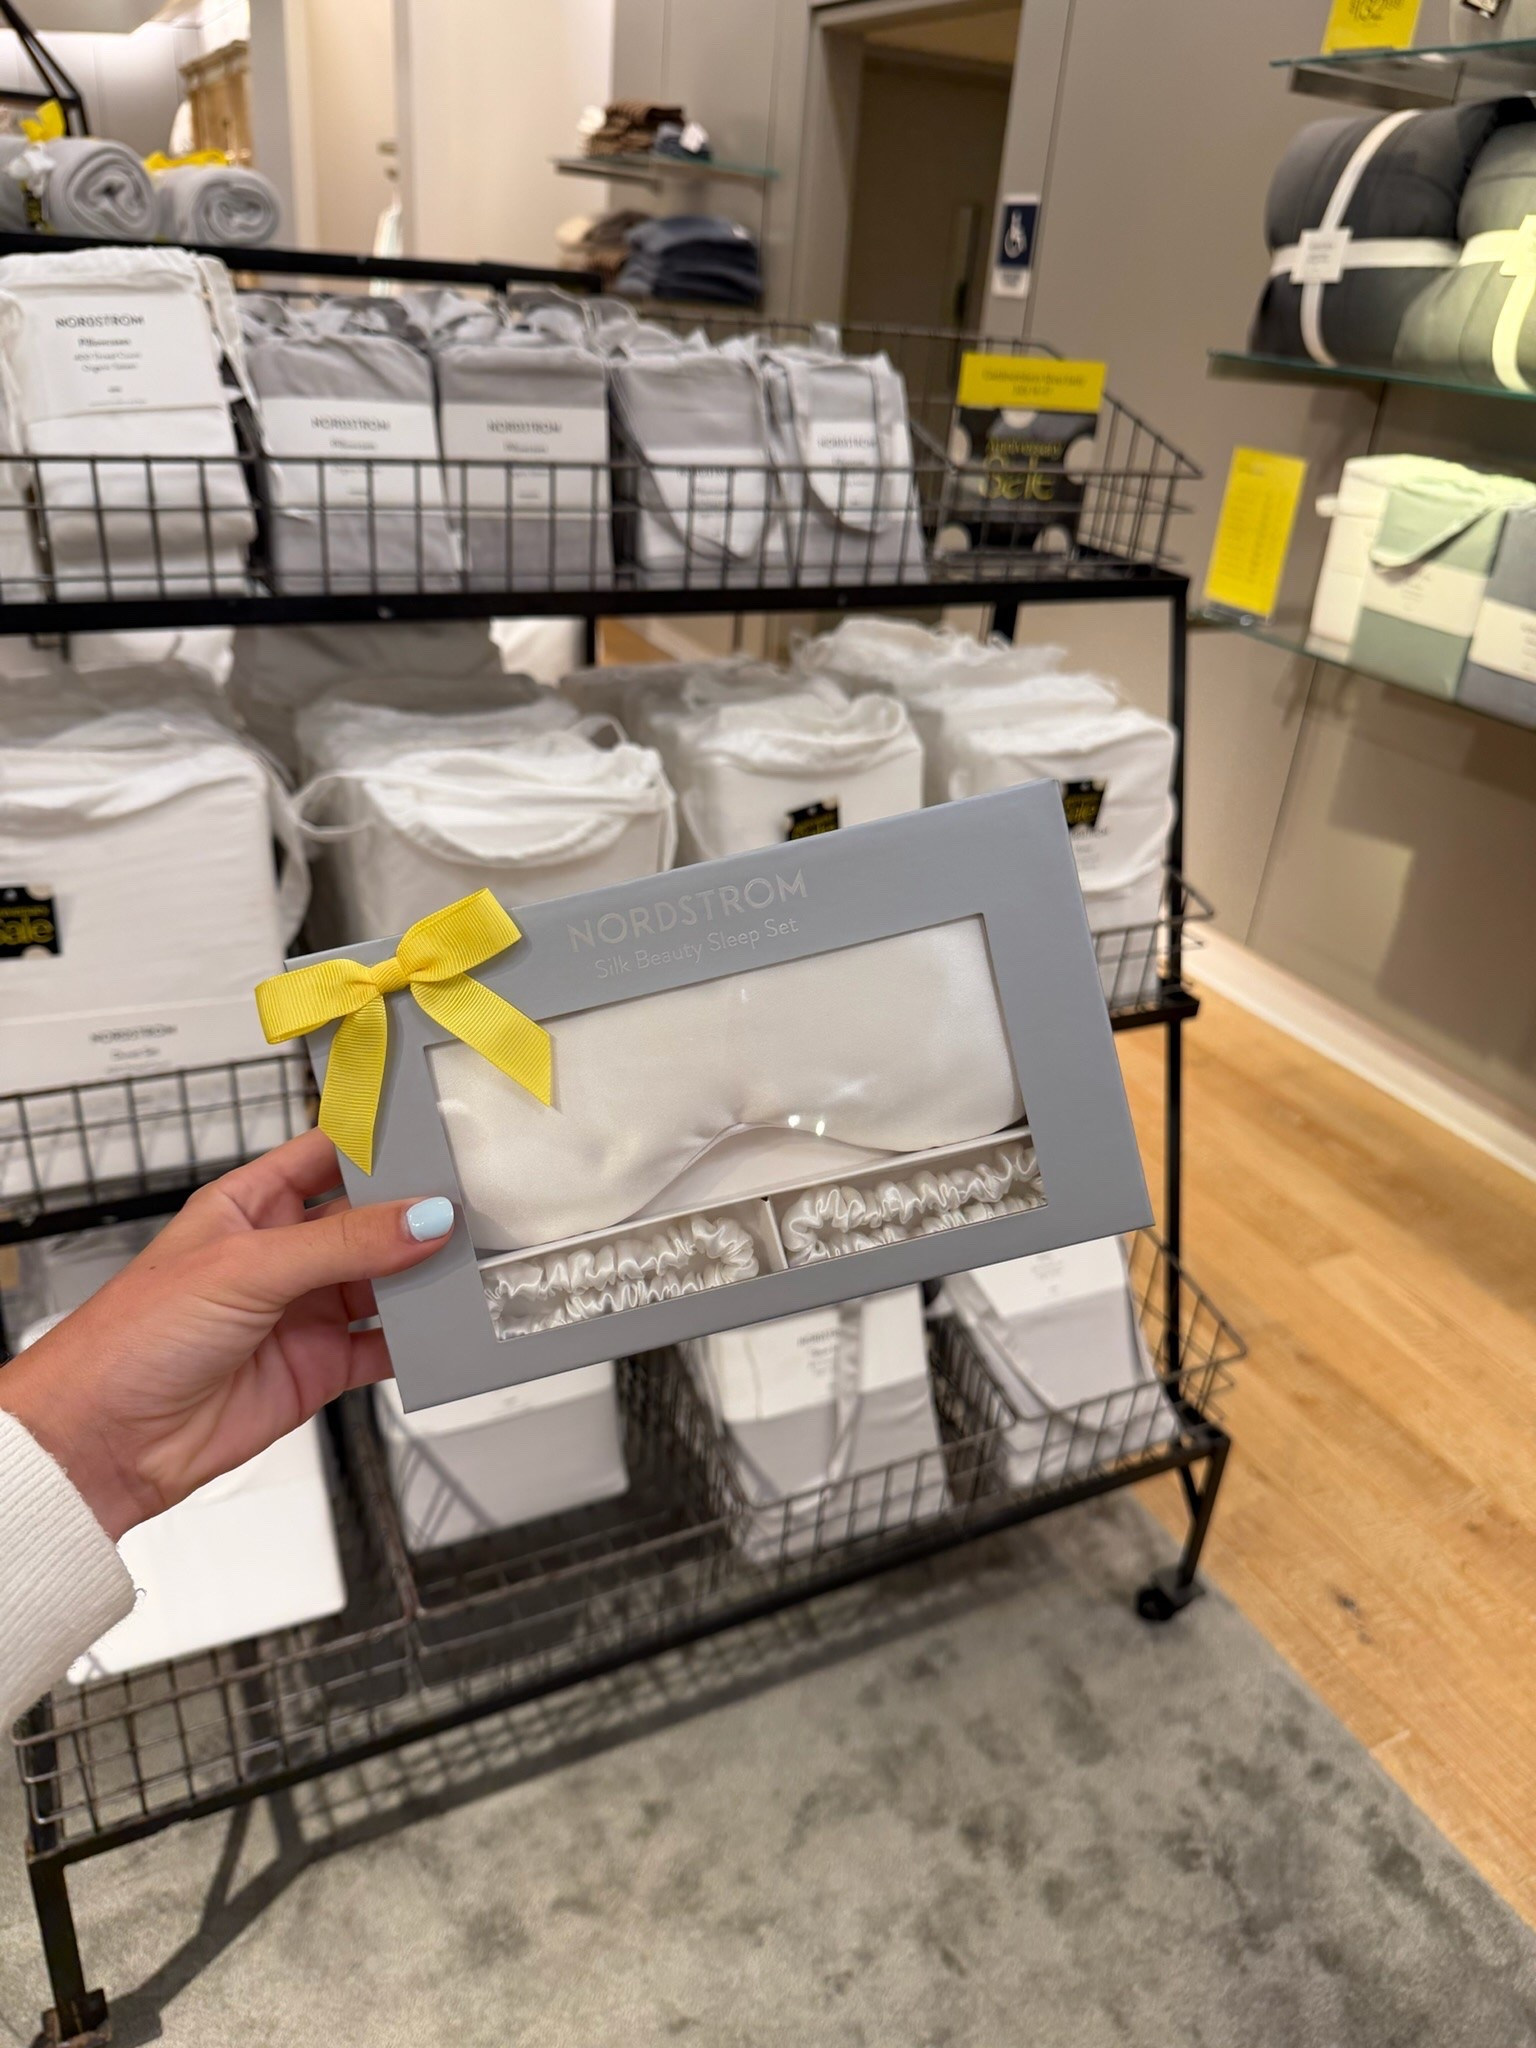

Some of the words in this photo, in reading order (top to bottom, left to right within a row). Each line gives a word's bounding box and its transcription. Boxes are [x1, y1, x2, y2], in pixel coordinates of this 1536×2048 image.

[55, 314, 145, 329] NORDSTROM
[0, 914, 55, 946] ale
[566, 868, 808, 953] NORDSTROM
[594, 954, 632, 979] Silk
[636, 942, 703, 964] Beauty
[707, 930, 760, 951] Sleep
[764, 917, 799, 938] Set
